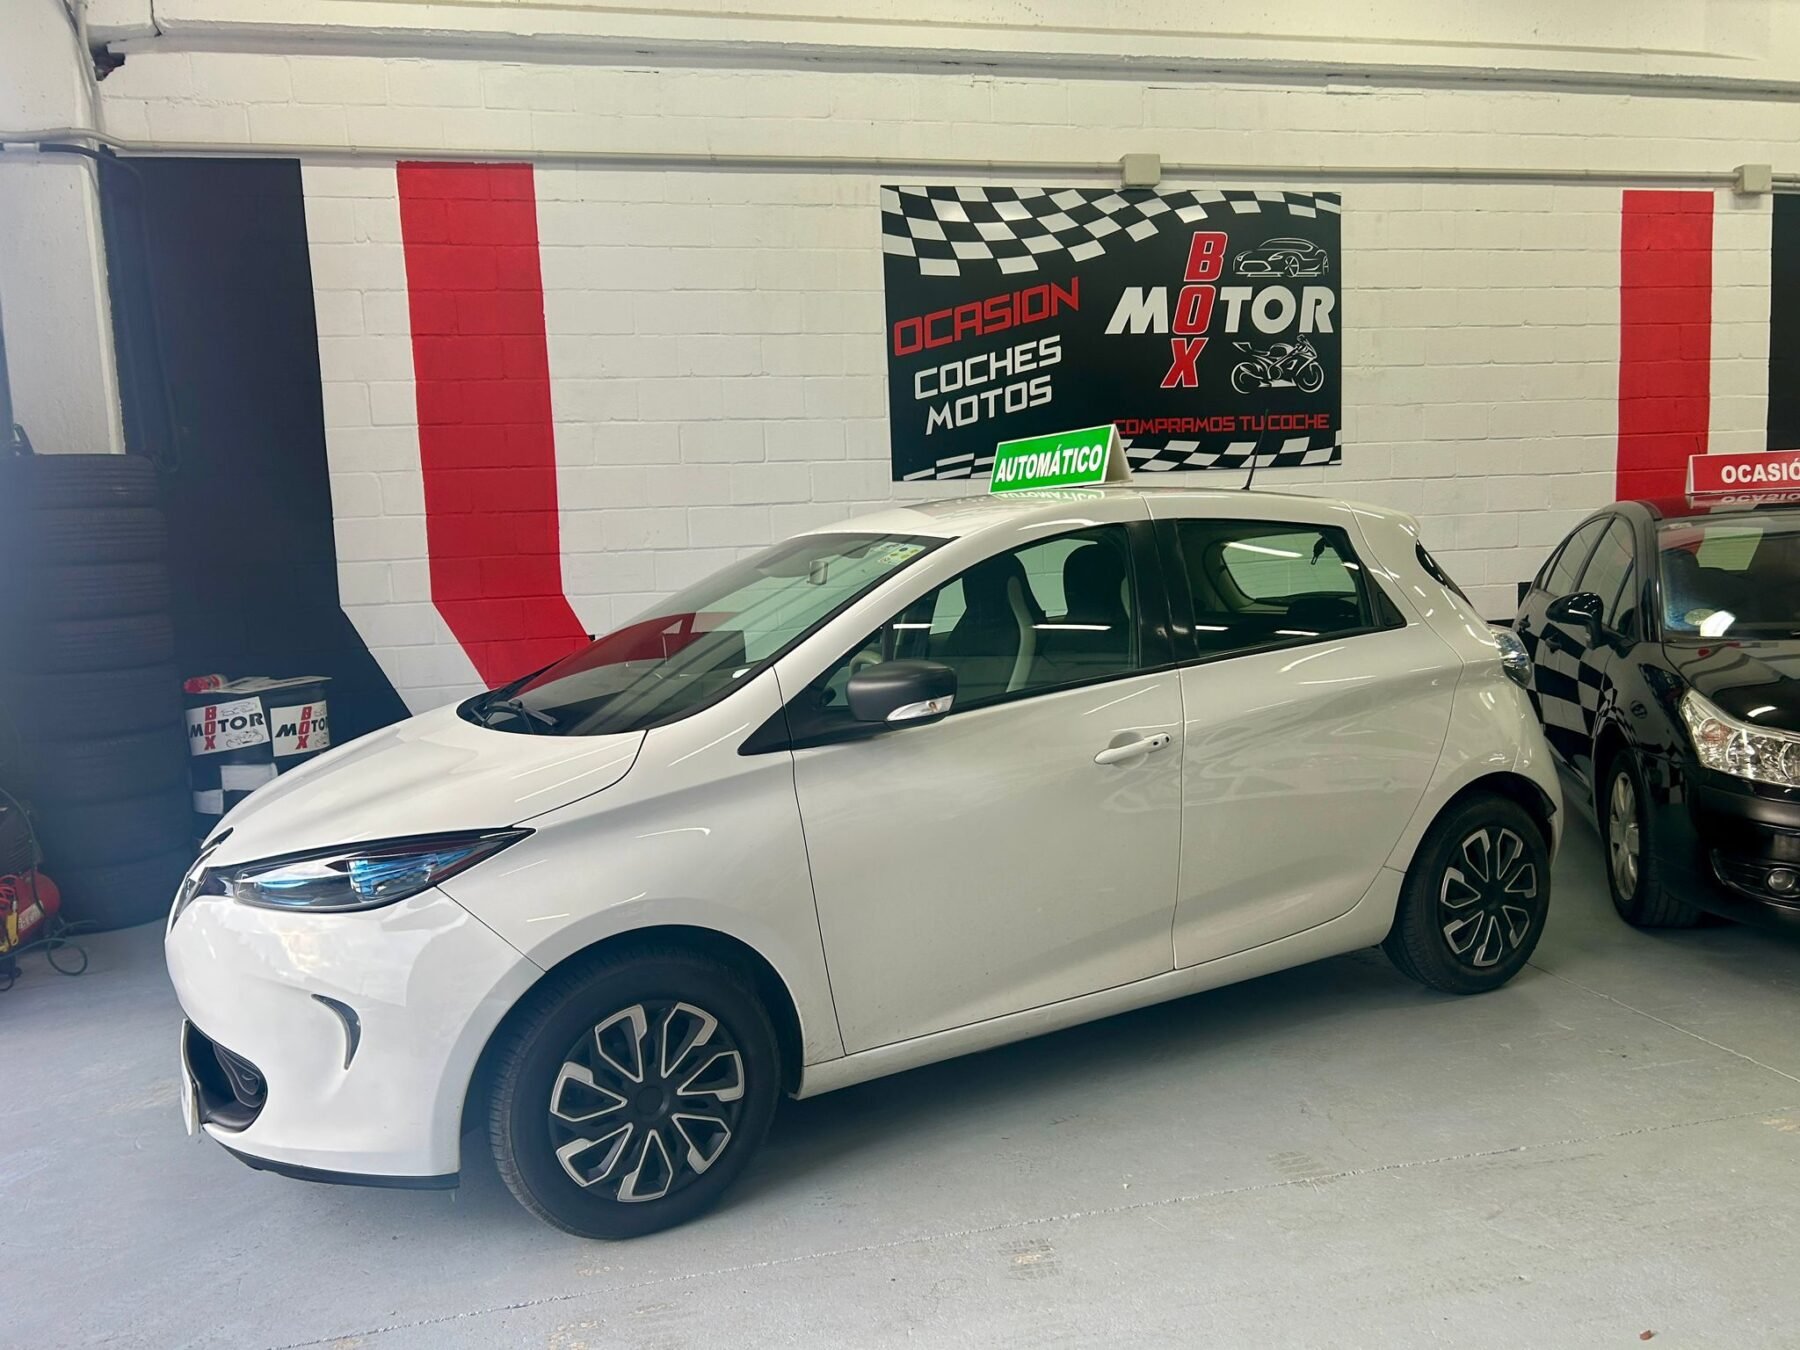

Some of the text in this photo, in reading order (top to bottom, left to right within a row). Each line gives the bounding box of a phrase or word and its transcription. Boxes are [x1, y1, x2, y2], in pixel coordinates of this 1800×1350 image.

[893, 276, 1080, 357] OCASION
[1104, 285, 1336, 335] MOTOR
[1159, 231, 1228, 389] BOX
[914, 334, 1062, 400] COCHES
[925, 374, 1053, 436] MOTOS
[1113, 413, 1330, 435] COMPRAMOS TU COCHE
[994, 443, 1103, 483] AUTOMÁTICO
[190, 712, 265, 739] MOTOR
[204, 705, 217, 750] BOX
[295, 705, 313, 750] BOX
